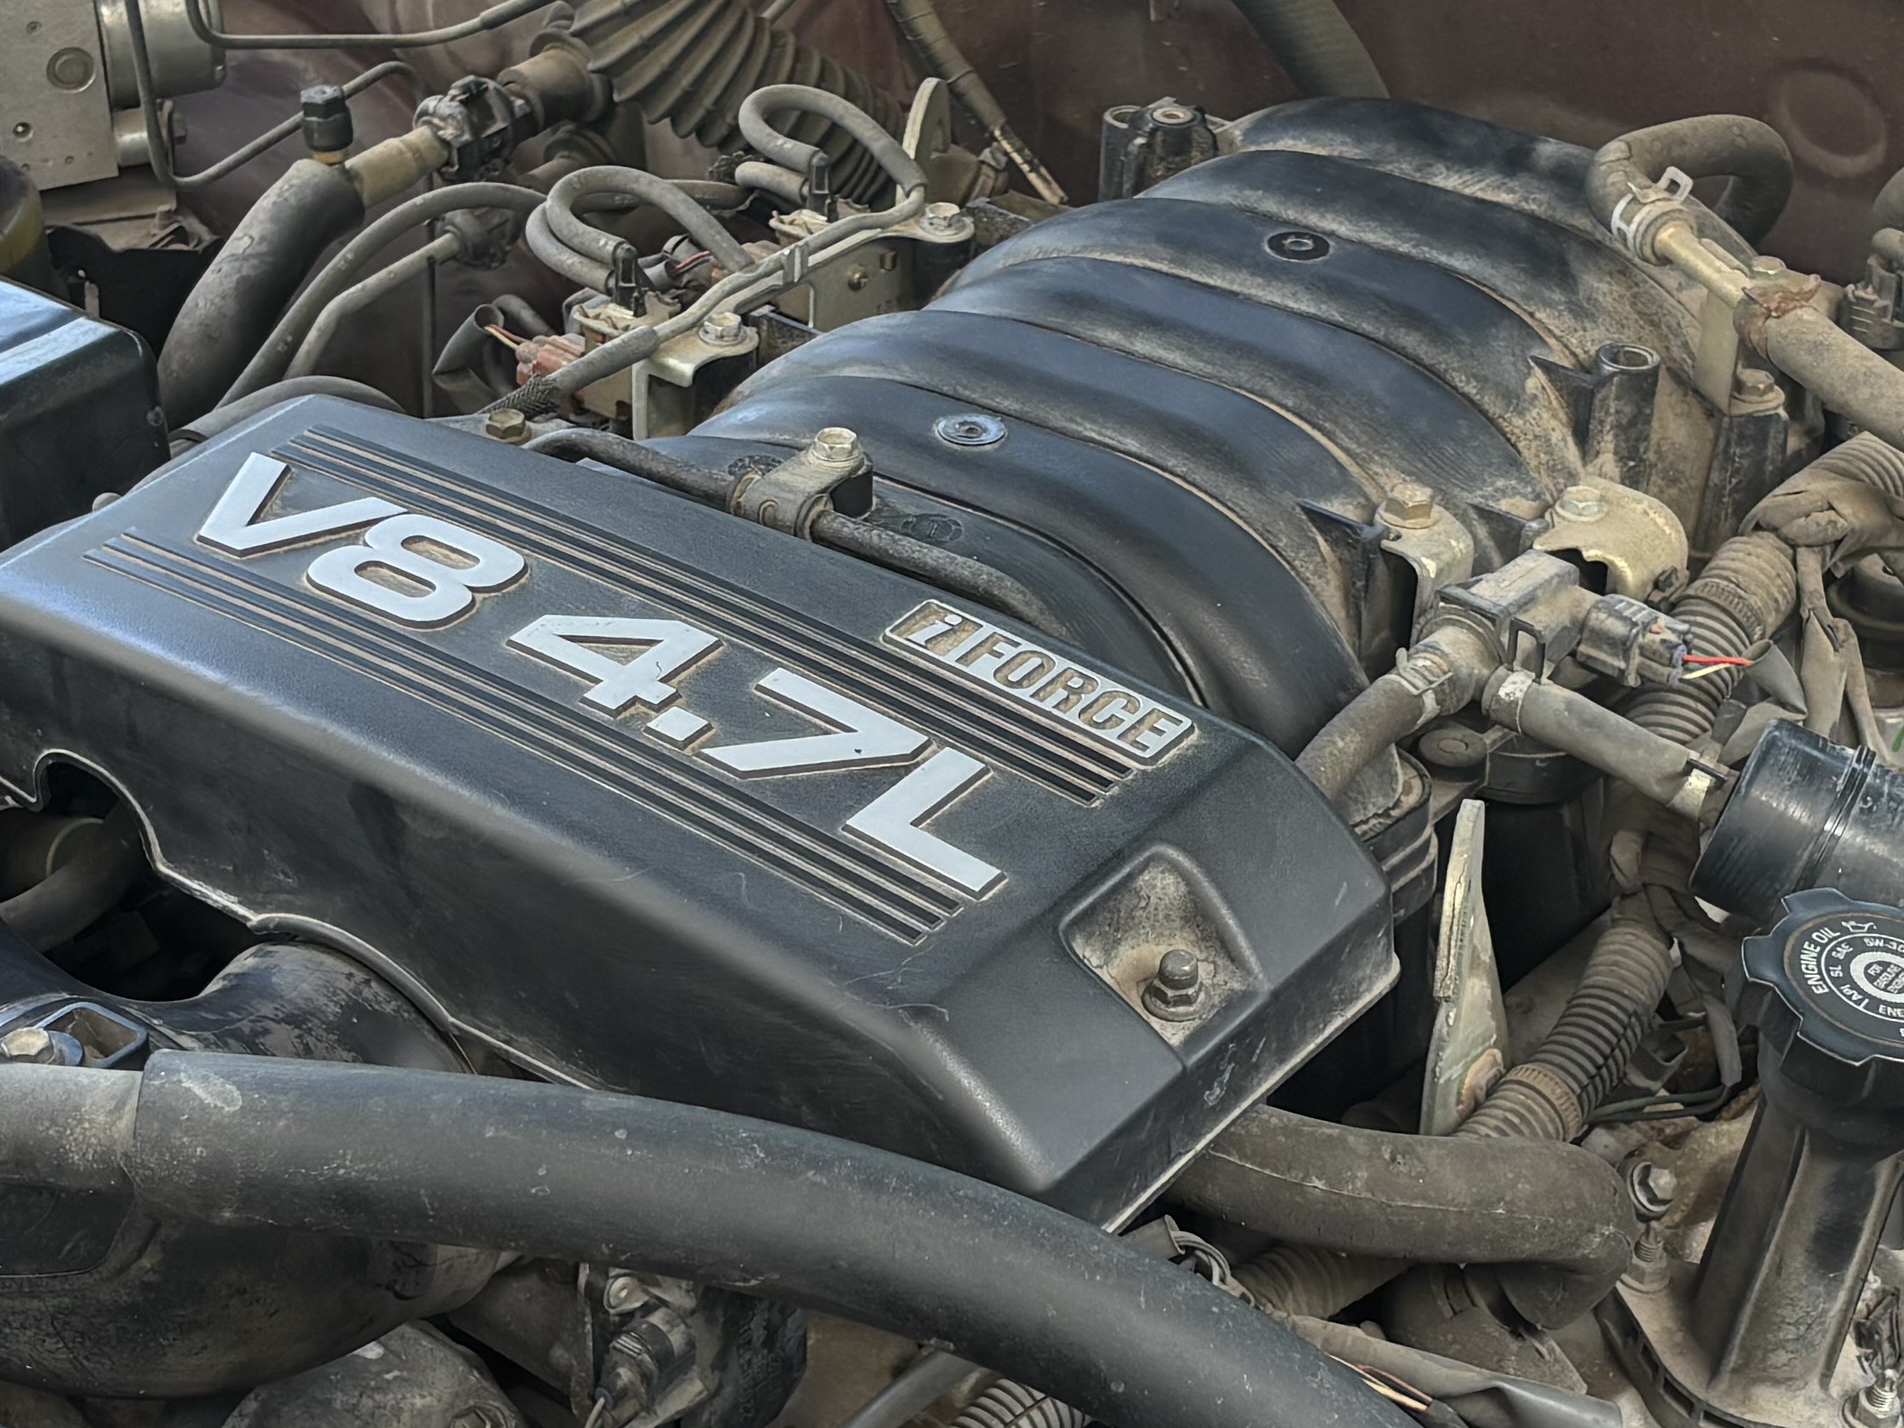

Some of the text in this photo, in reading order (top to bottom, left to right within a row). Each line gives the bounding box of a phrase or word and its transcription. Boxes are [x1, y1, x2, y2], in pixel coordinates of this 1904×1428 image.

[195, 452, 1006, 900] V8 4.7L
[954, 632, 1184, 753] FORCE
[1800, 927, 1841, 996] ENGINE OIL
[1829, 965, 1843, 978] SL
[1832, 942, 1854, 960] SAE
